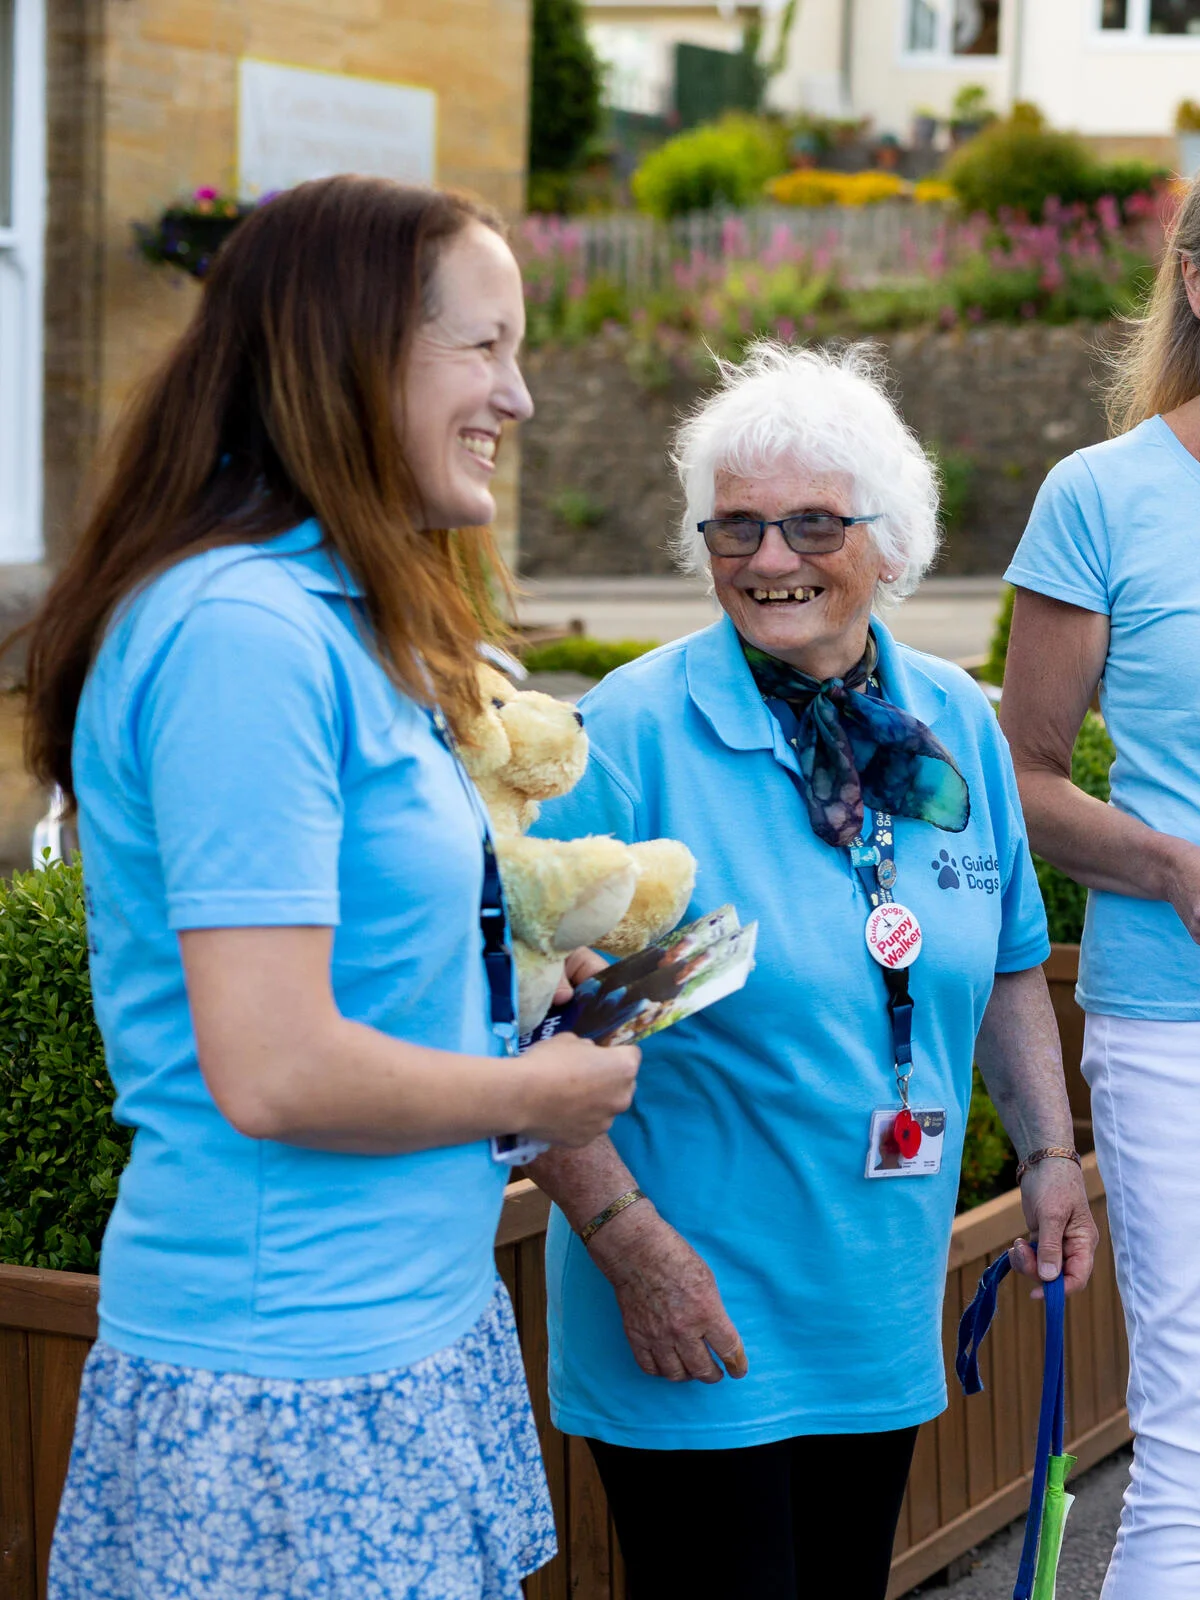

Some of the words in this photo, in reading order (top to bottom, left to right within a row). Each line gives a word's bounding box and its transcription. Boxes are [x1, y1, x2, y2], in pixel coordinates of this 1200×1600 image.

[962, 855, 1000, 873] Guide
[967, 874, 999, 895] Dogs
[870, 915, 882, 944] Guide
[881, 908, 903, 917] Dogs
[876, 916, 913, 955] Puppy
[883, 928, 921, 967] Walker
